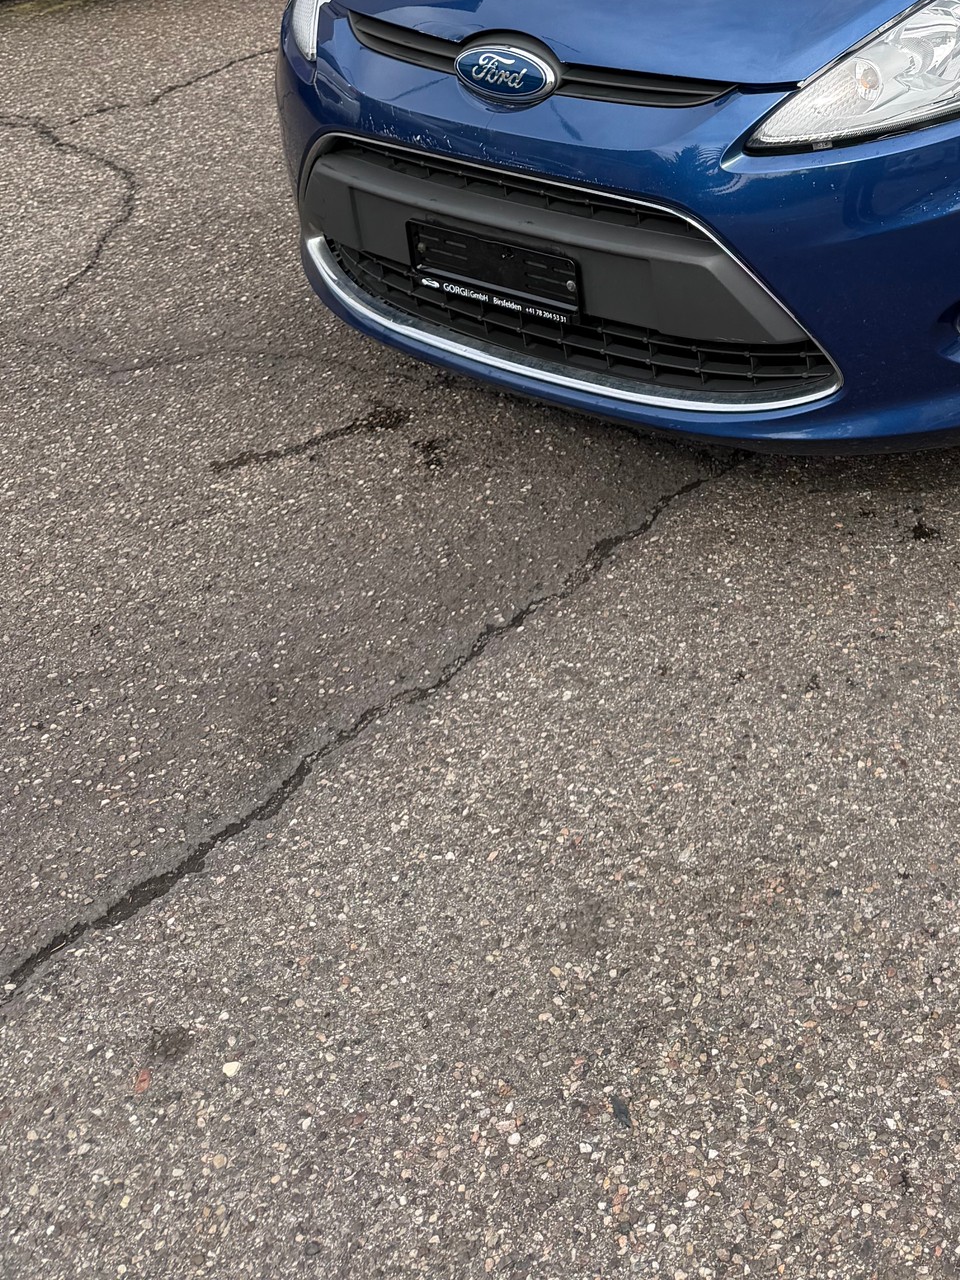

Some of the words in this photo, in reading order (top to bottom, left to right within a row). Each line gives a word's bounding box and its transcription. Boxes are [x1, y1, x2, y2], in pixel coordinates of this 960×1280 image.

[471, 53, 528, 89] Ford
[442, 282, 468, 297] GORGI
[493, 296, 522, 311] Birsfelden
